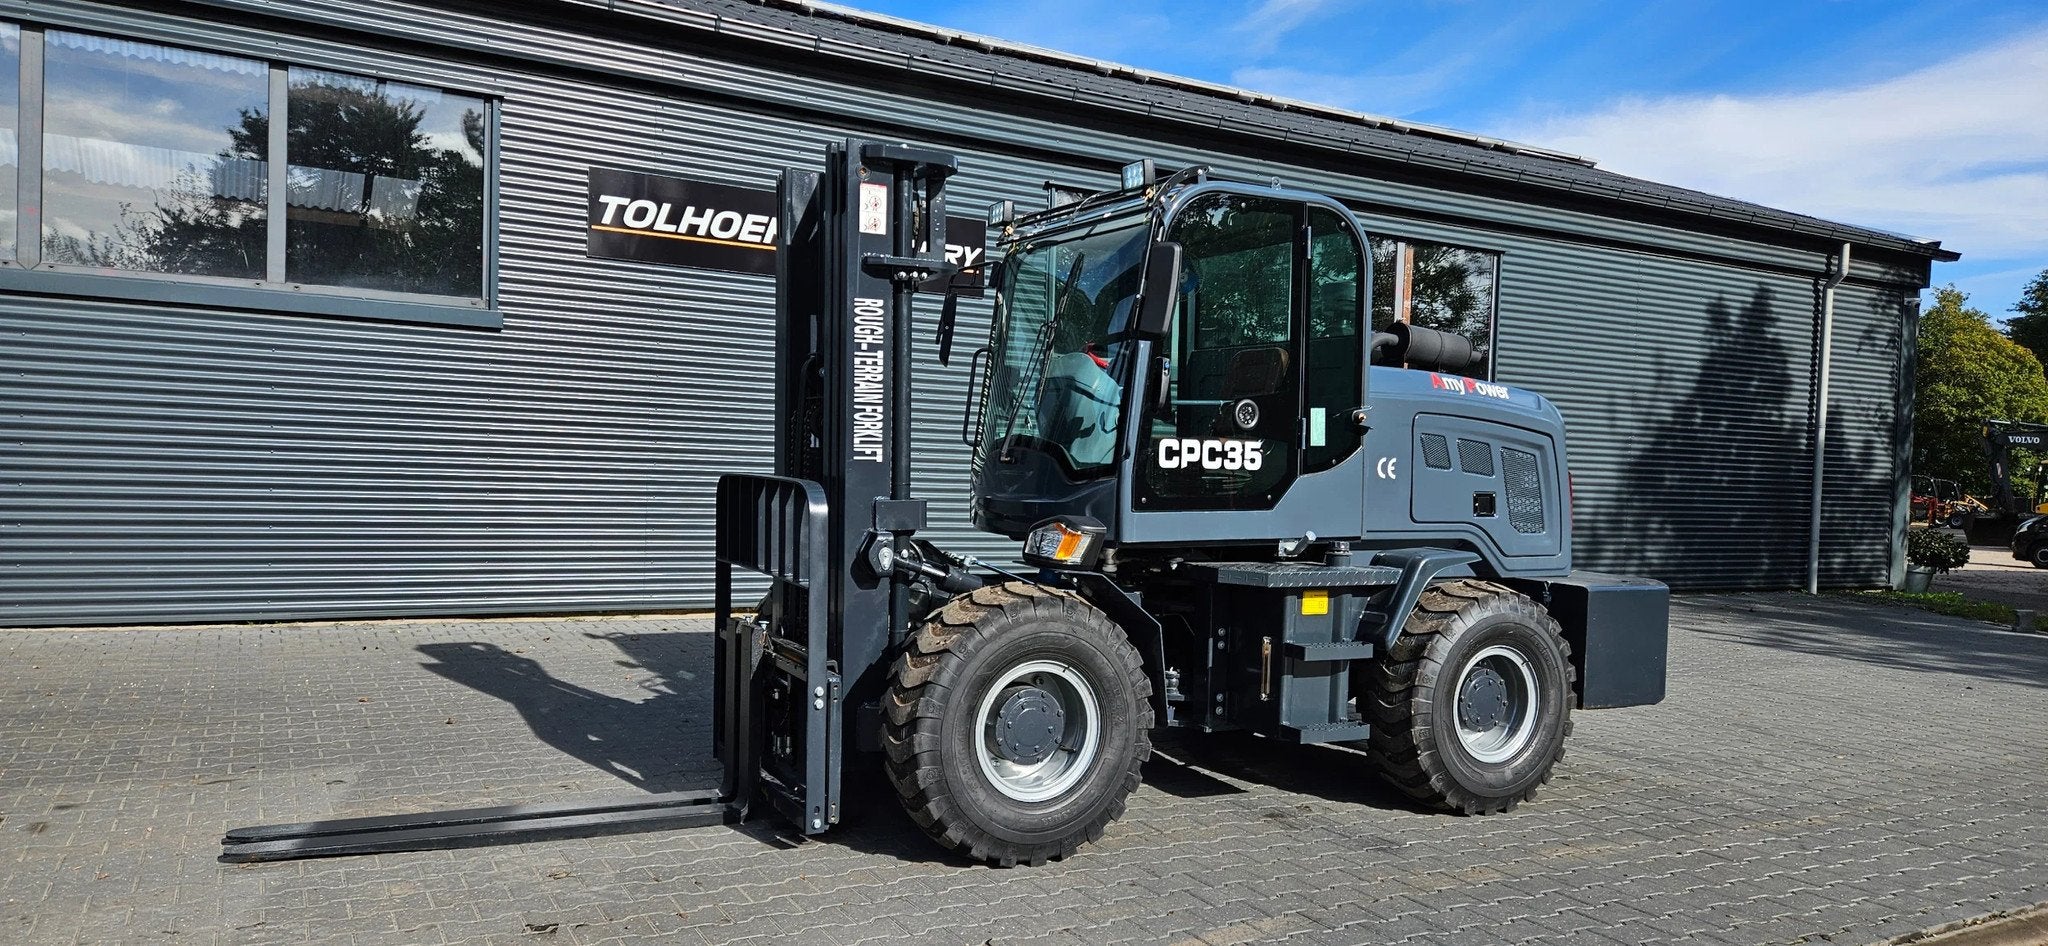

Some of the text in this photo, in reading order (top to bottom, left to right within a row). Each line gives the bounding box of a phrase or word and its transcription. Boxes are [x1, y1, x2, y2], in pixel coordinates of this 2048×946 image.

[853, 404, 884, 463] FORKLIFT
[2008, 435, 2040, 444] VOLVO
[1158, 438, 1264, 471] CPC35
[1376, 457, 1397, 480] CE
